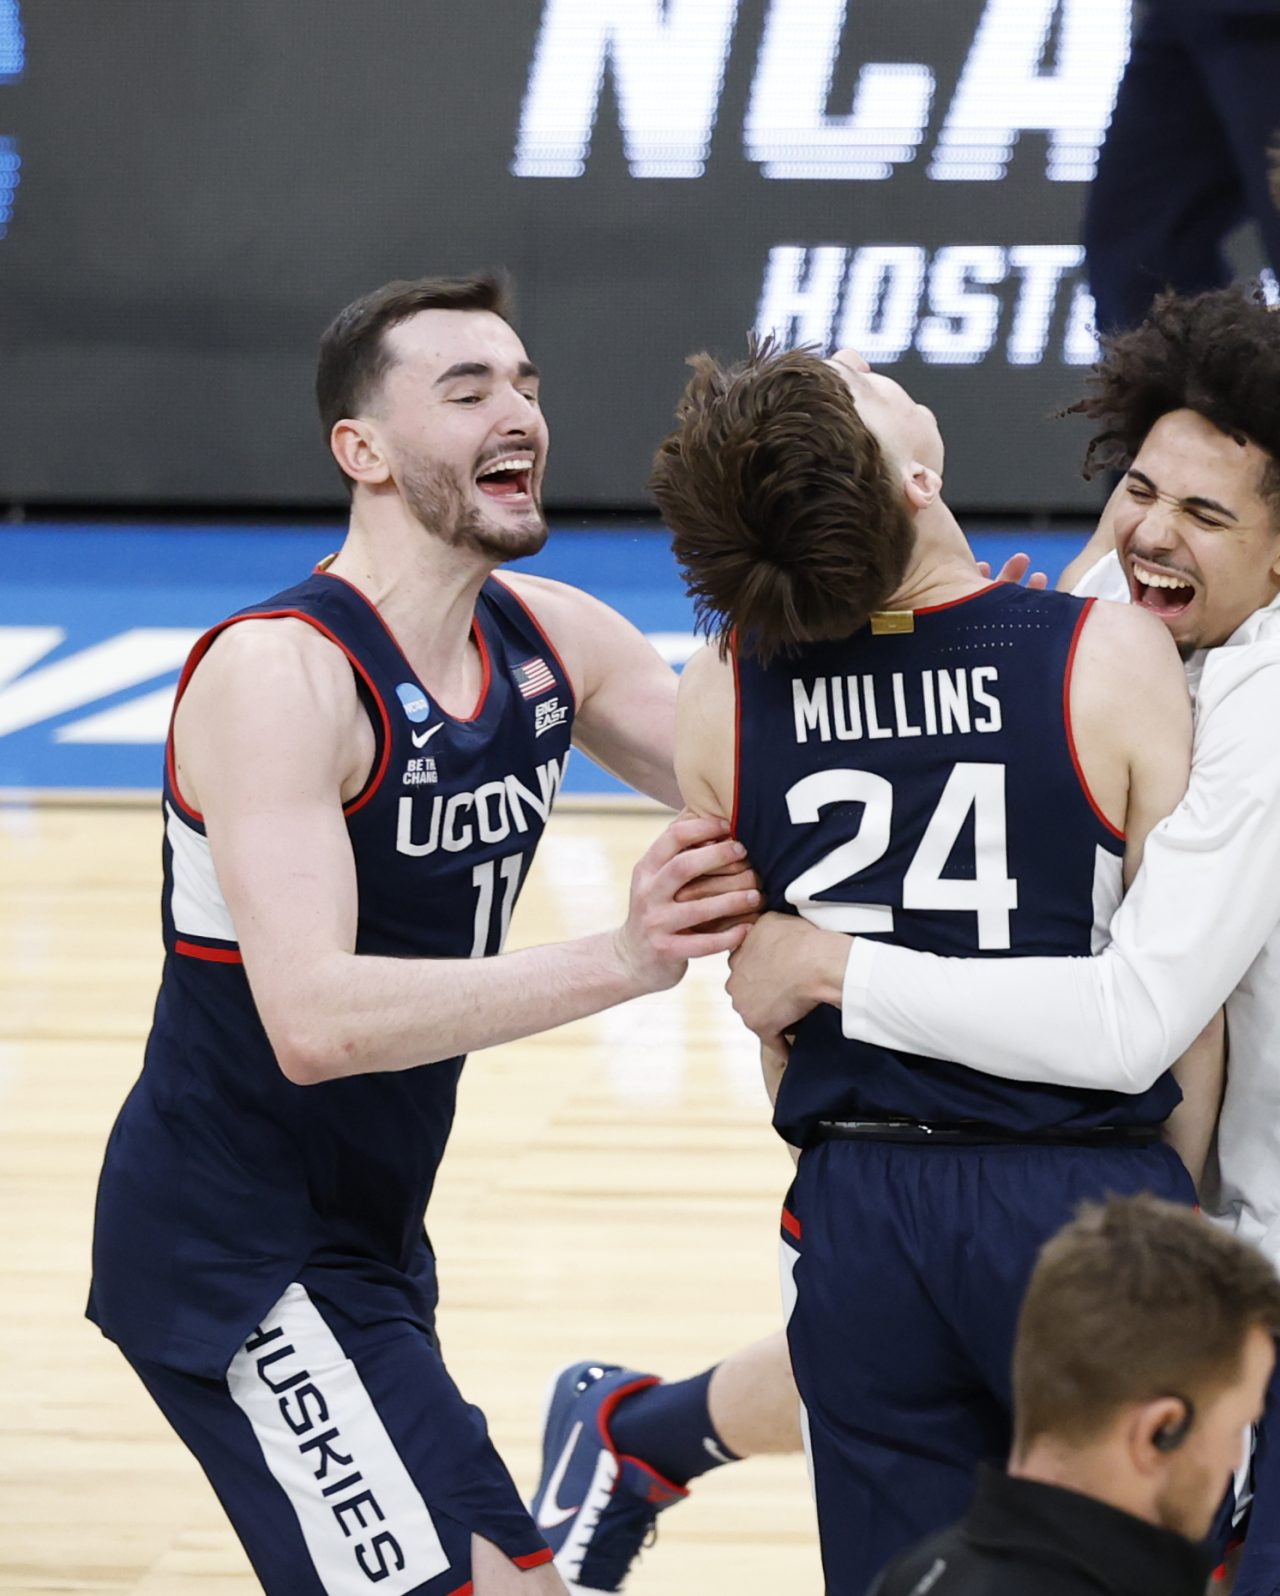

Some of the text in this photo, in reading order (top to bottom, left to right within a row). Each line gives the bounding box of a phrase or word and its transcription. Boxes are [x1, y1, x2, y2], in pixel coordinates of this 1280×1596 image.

[510, 0, 1132, 181] NCA
[757, 244, 1103, 365] HOST
[535, 697, 558, 717] BIG
[535, 706, 568, 730] EAST
[791, 666, 1001, 743] MULLINS
[402, 770, 438, 785] CHANG
[407, 759, 424, 771] BE
[785, 762, 1018, 950] 24
[470, 852, 524, 958] 11
